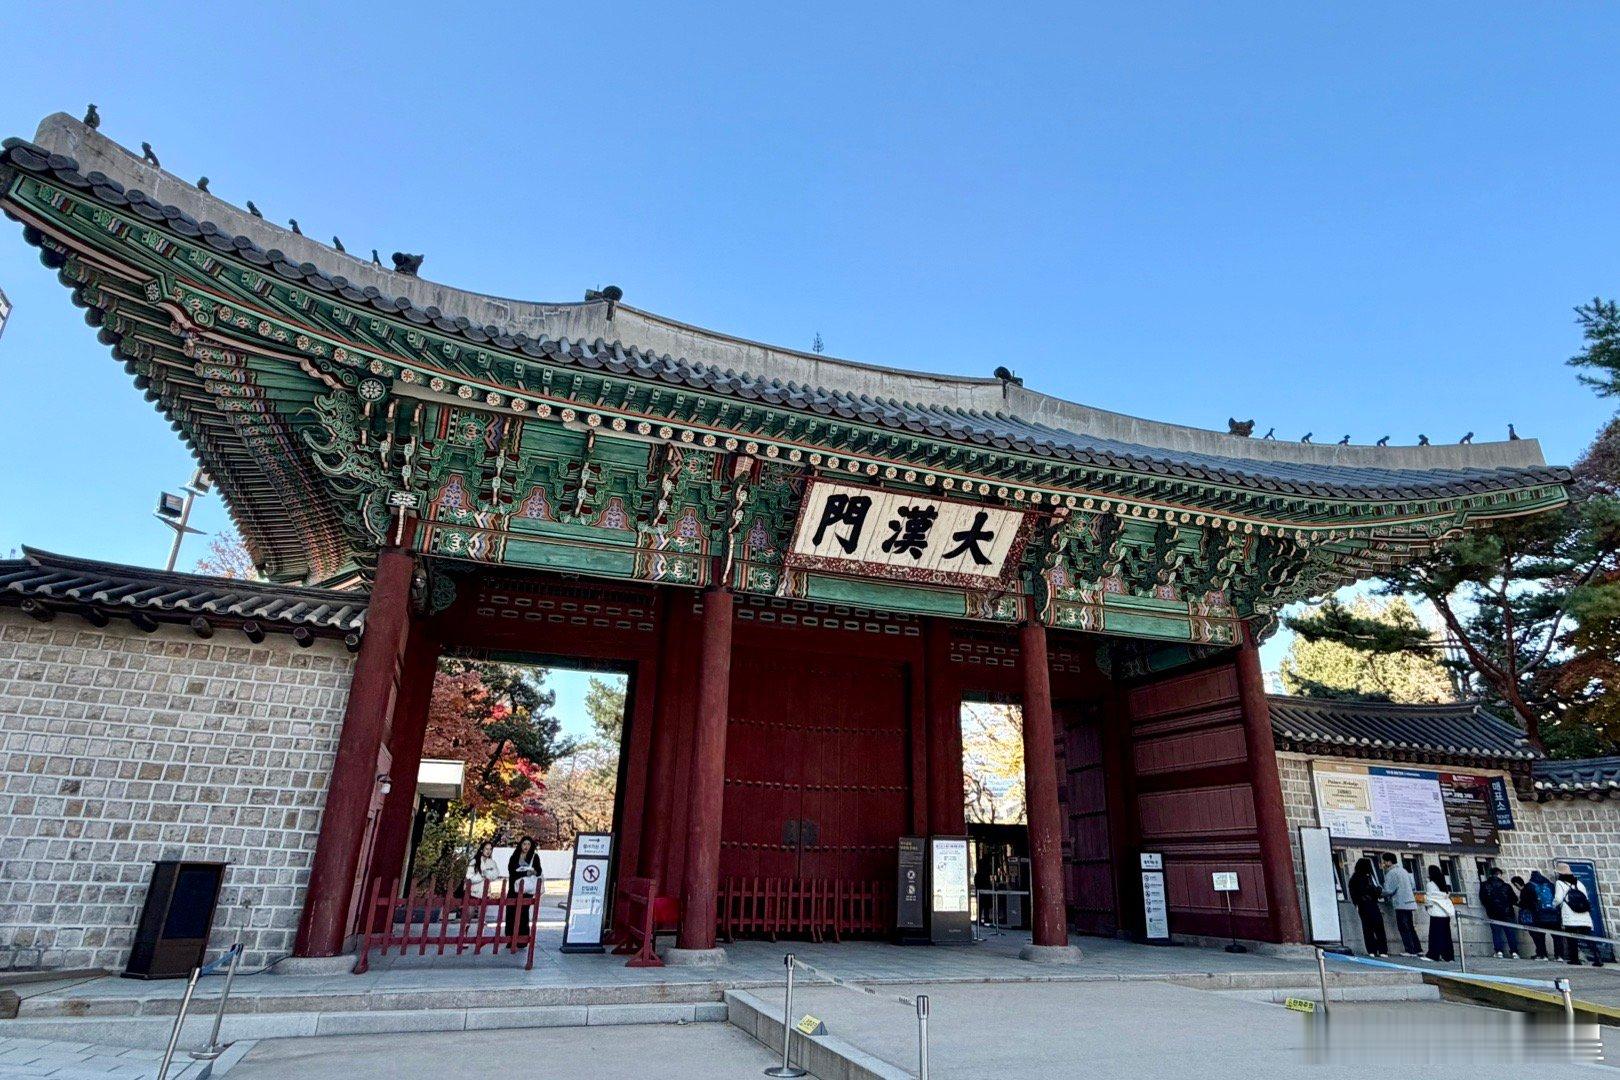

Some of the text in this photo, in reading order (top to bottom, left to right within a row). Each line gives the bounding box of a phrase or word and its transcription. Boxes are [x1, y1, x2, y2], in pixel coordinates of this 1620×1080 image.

[812, 494, 995, 566] 大漢門
[1491, 781, 1507, 811] 매표소
